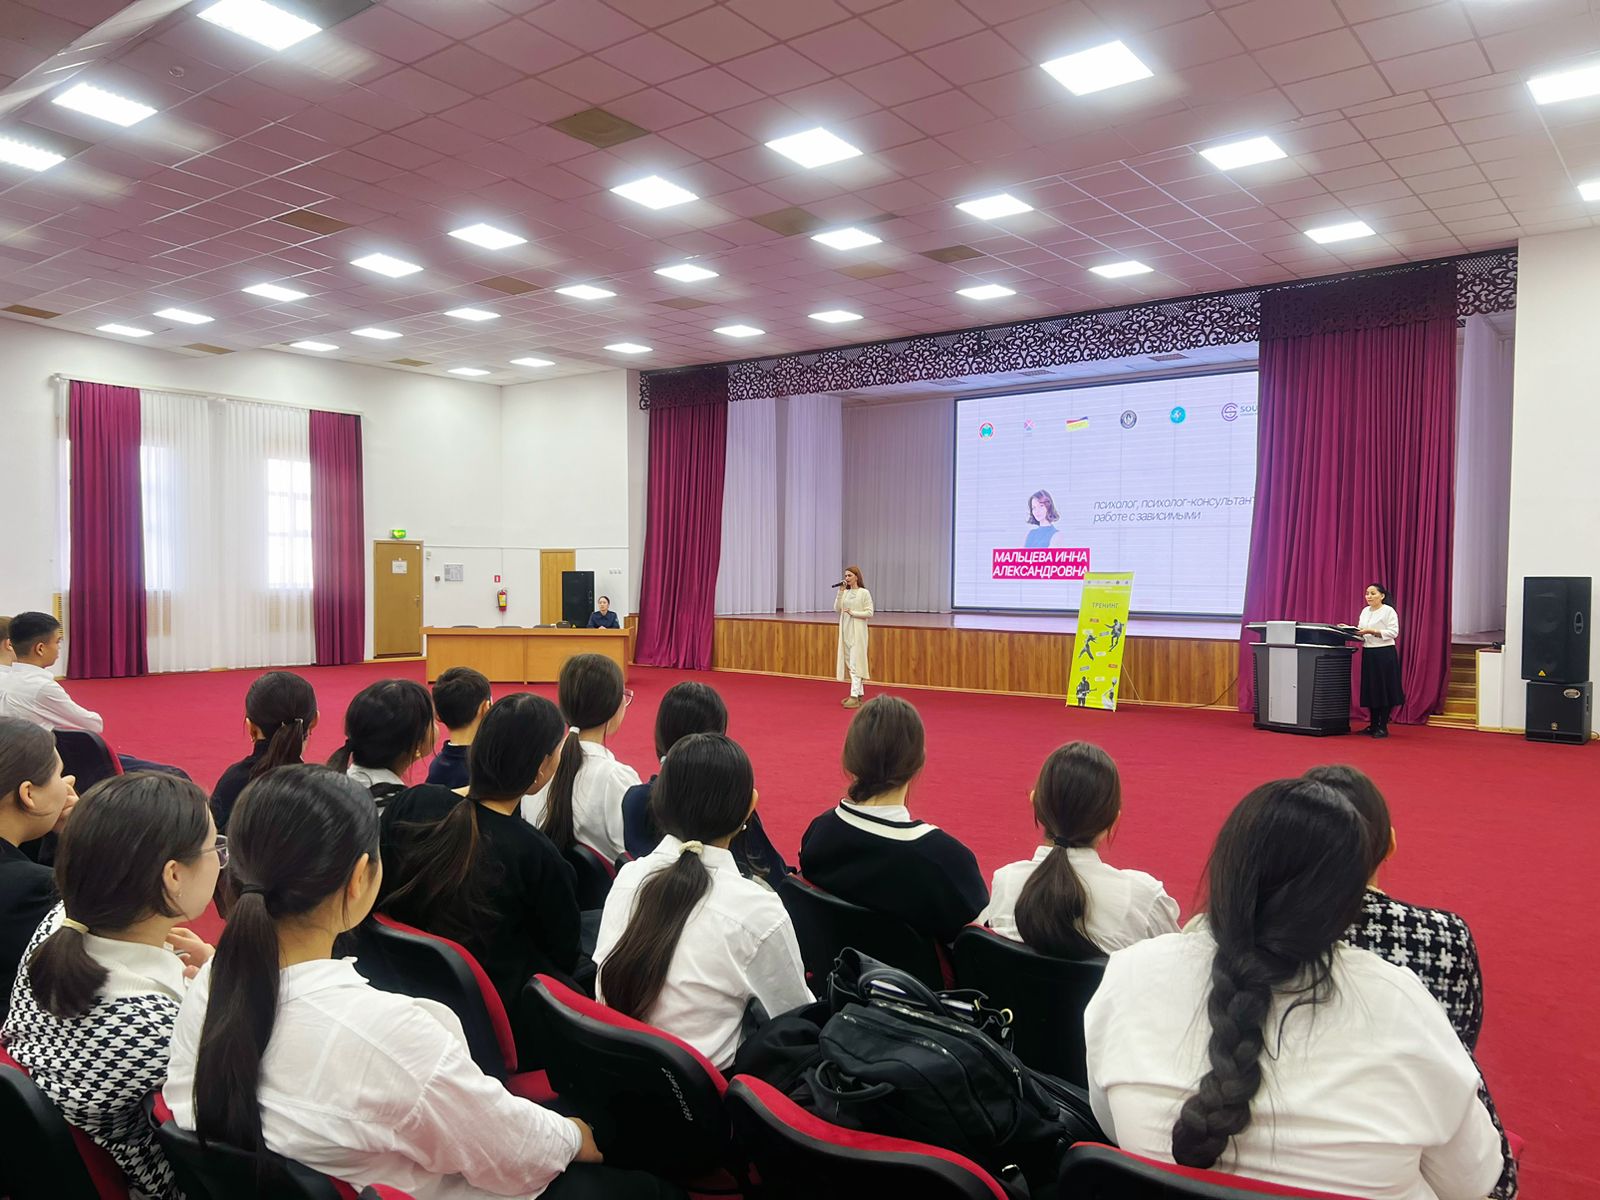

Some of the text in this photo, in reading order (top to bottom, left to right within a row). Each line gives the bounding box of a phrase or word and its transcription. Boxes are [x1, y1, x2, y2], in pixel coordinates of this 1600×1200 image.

[1094, 499, 1139, 510] психолог,
[1093, 510, 1201, 523] работе с зависимыми
[994, 551, 1088, 564] МАЛЬЦЕВА ИННА
[992, 565, 1088, 578] АЛЕКСАНДРОВНА
